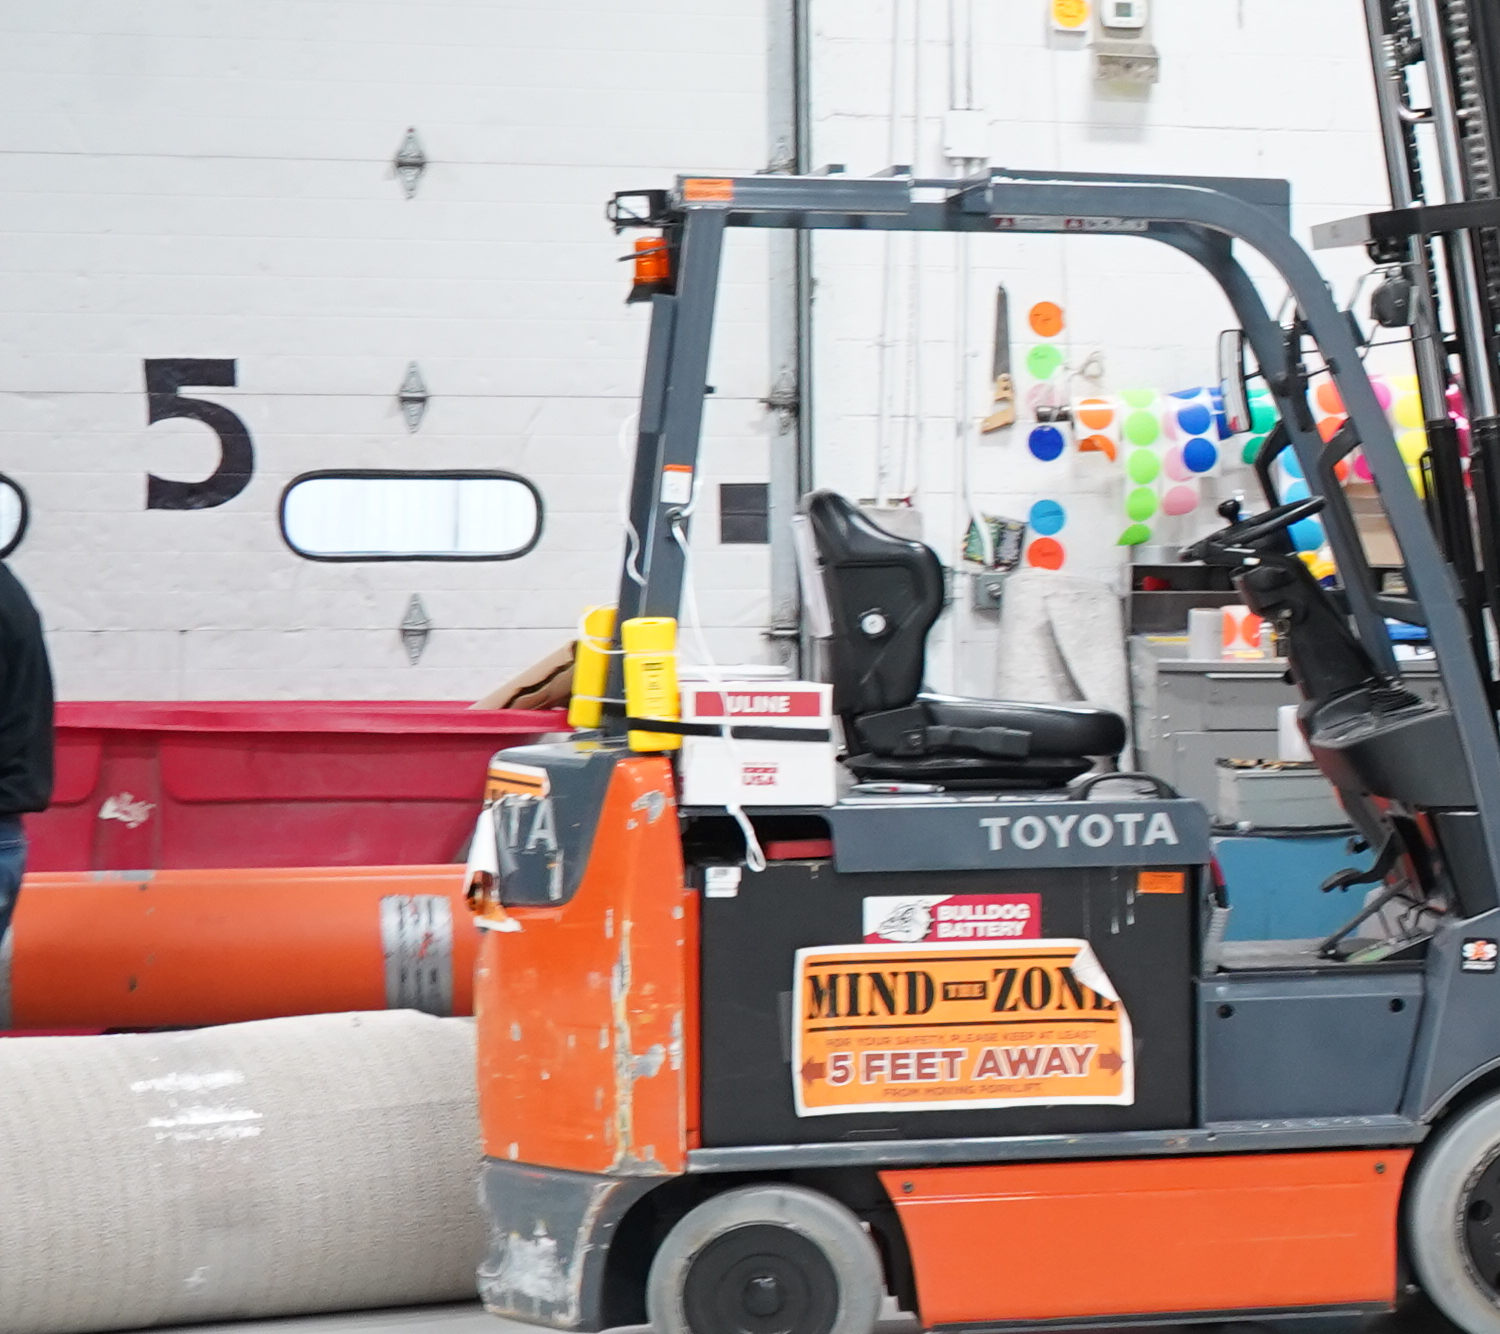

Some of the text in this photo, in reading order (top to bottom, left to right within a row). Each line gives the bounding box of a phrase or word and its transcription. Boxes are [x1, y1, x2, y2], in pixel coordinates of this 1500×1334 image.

[144, 358, 256, 511] 5
[727, 695, 790, 713] ULINE
[979, 812, 1179, 851] TOYOTA
[937, 904, 1031, 921] BULLDOG
[937, 919, 1027, 938] BATTERY
[807, 970, 934, 1019] MIND
[826, 1043, 1099, 1086] 5 FEET AWAY
